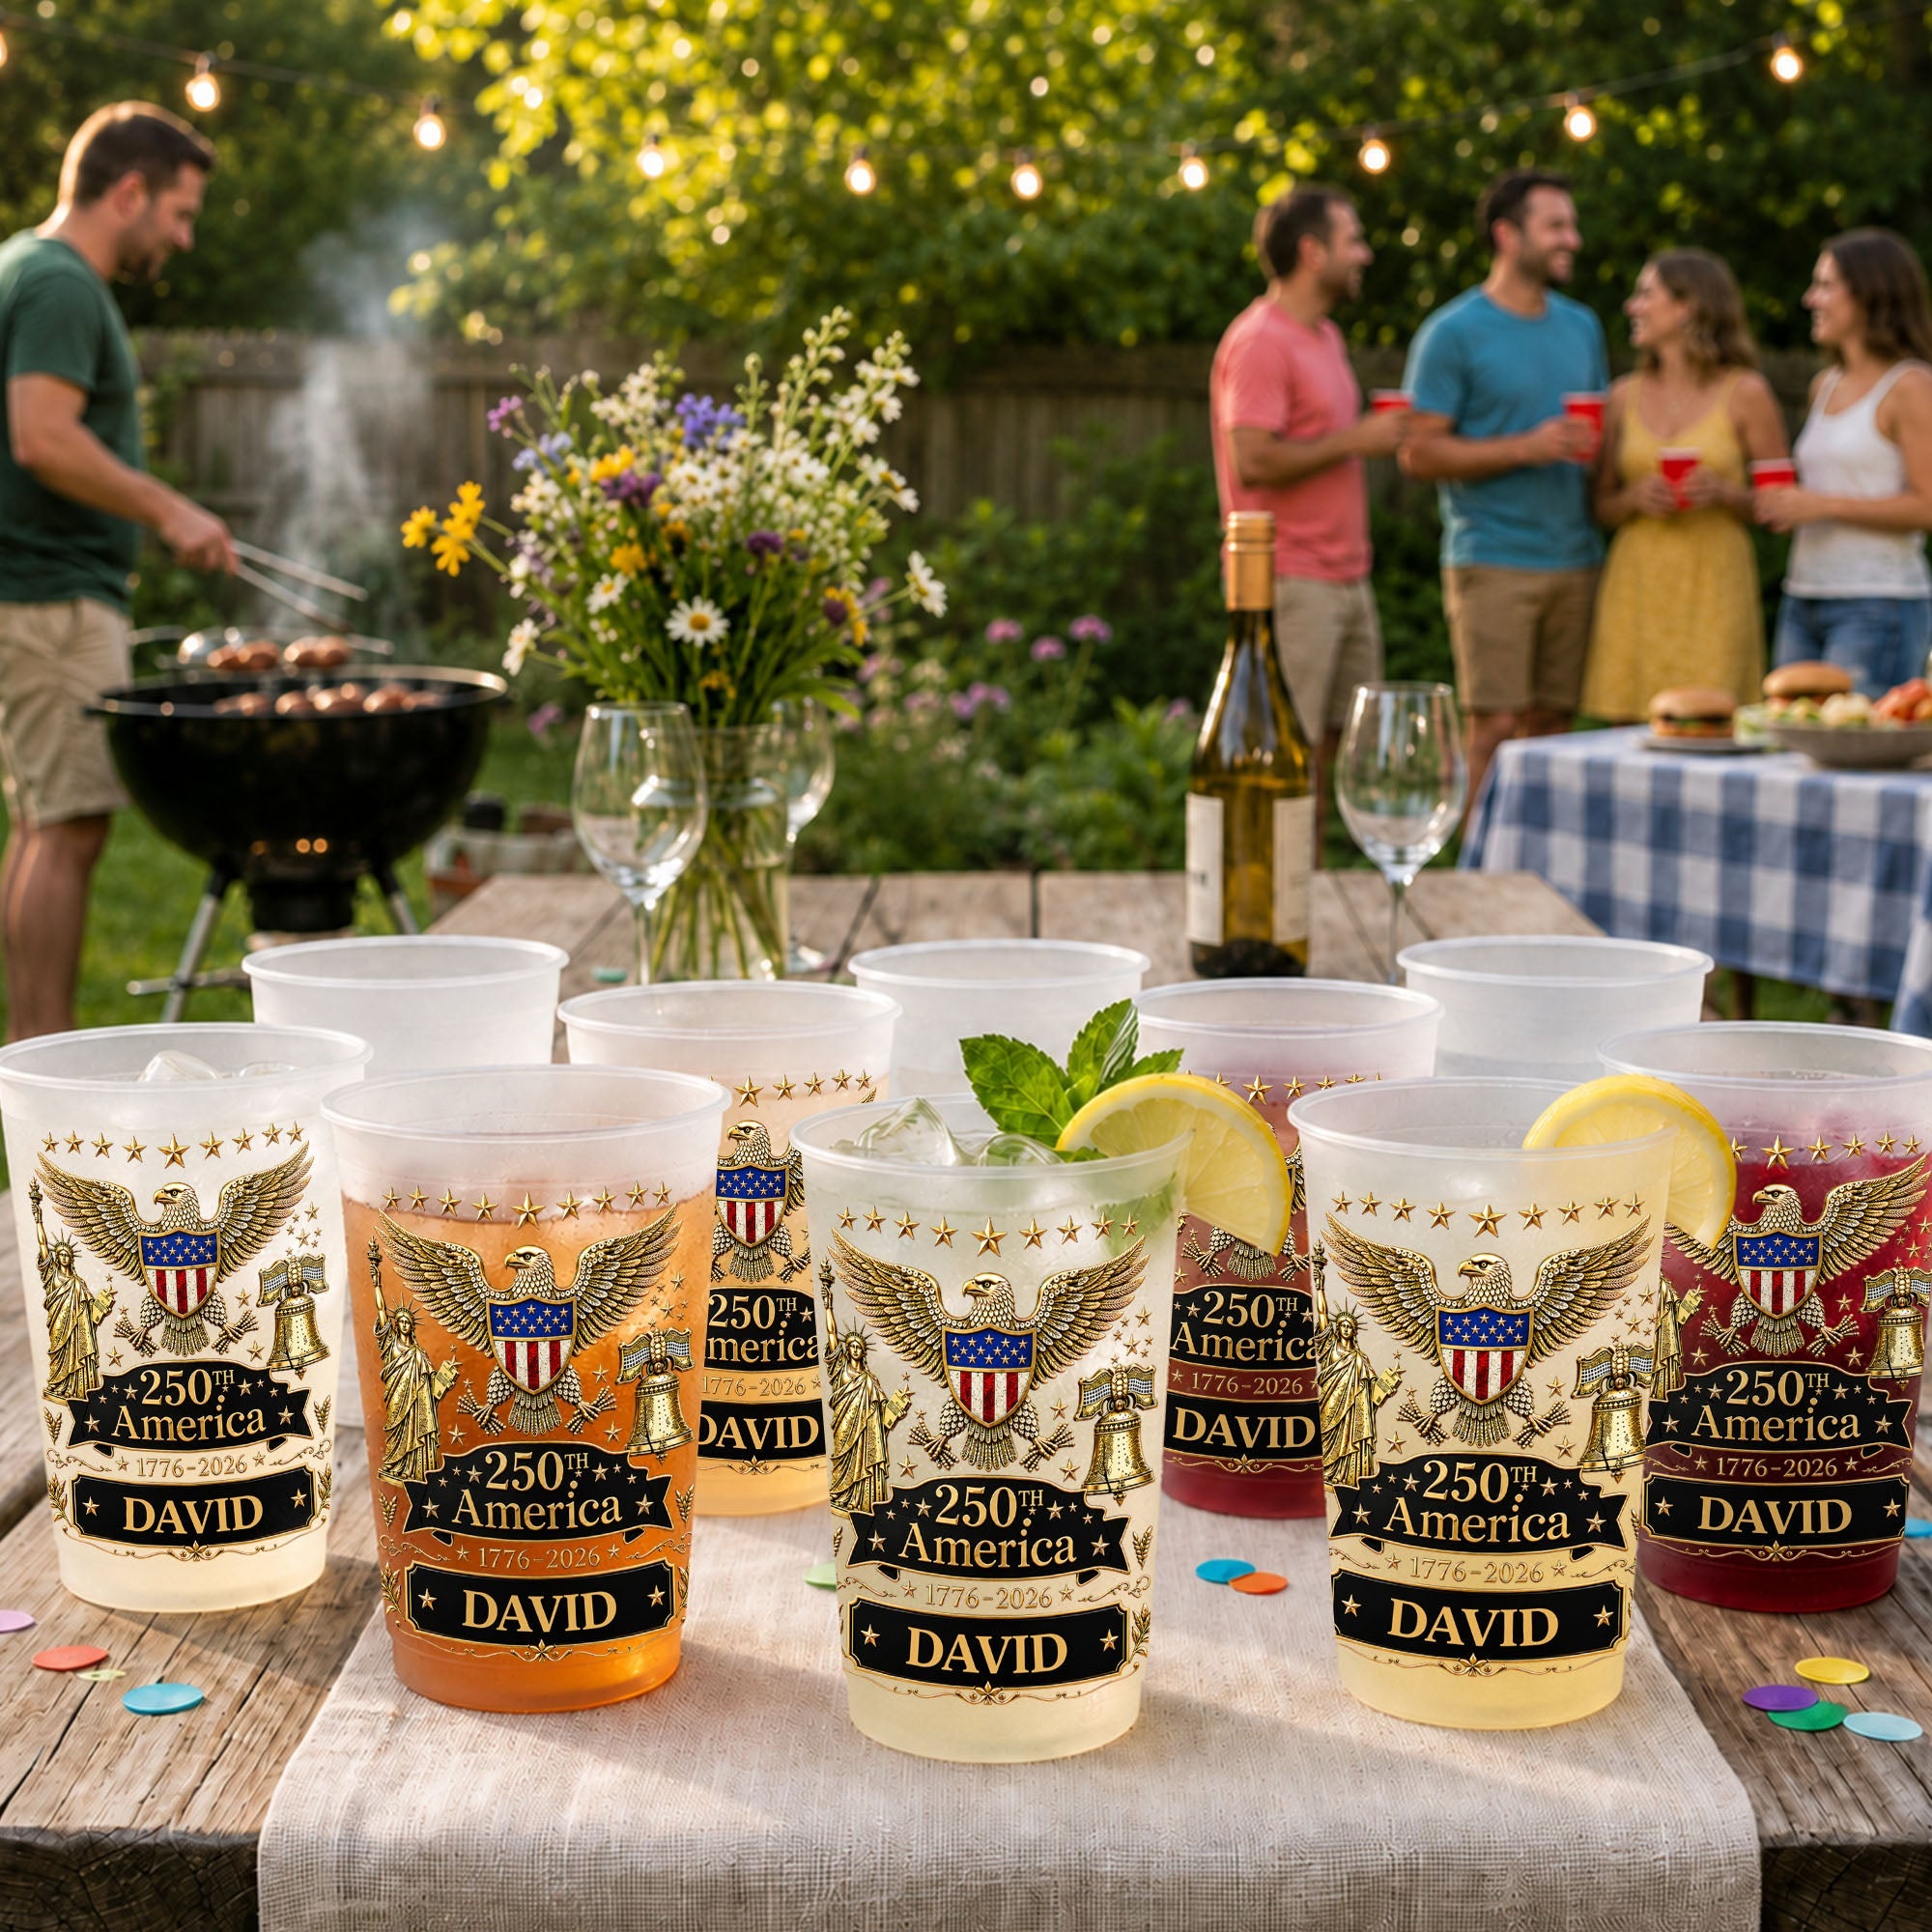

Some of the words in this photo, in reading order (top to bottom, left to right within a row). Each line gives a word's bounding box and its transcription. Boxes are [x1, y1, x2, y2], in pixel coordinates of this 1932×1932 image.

[705, 1329, 819, 1363] merica
[1192, 1372, 1303, 1395] 1776-2026
[111, 1405, 267, 1441] America
[1173, 1406, 1316, 1449] DAVID
[1691, 1405, 1861, 1442] America
[136, 1457, 248, 1478] 1776-2026
[1717, 1457, 1837, 1478] 1776-2026
[123, 1494, 263, 1534] DAVID
[452, 1488, 623, 1531] America
[1382, 1496, 1571, 1543] America
[1697, 1495, 1852, 1535] DAVID
[478, 1547, 601, 1570] 1776-2026
[898, 1521, 1077, 1569] America
[1409, 1555, 1545, 1584] 1776-2026
[462, 1589, 617, 1634] DAVID
[925, 1583, 1053, 1609] 1776-2026
[1387, 1597, 1559, 1647] DAVID
[905, 1626, 1067, 1675] DAVID
